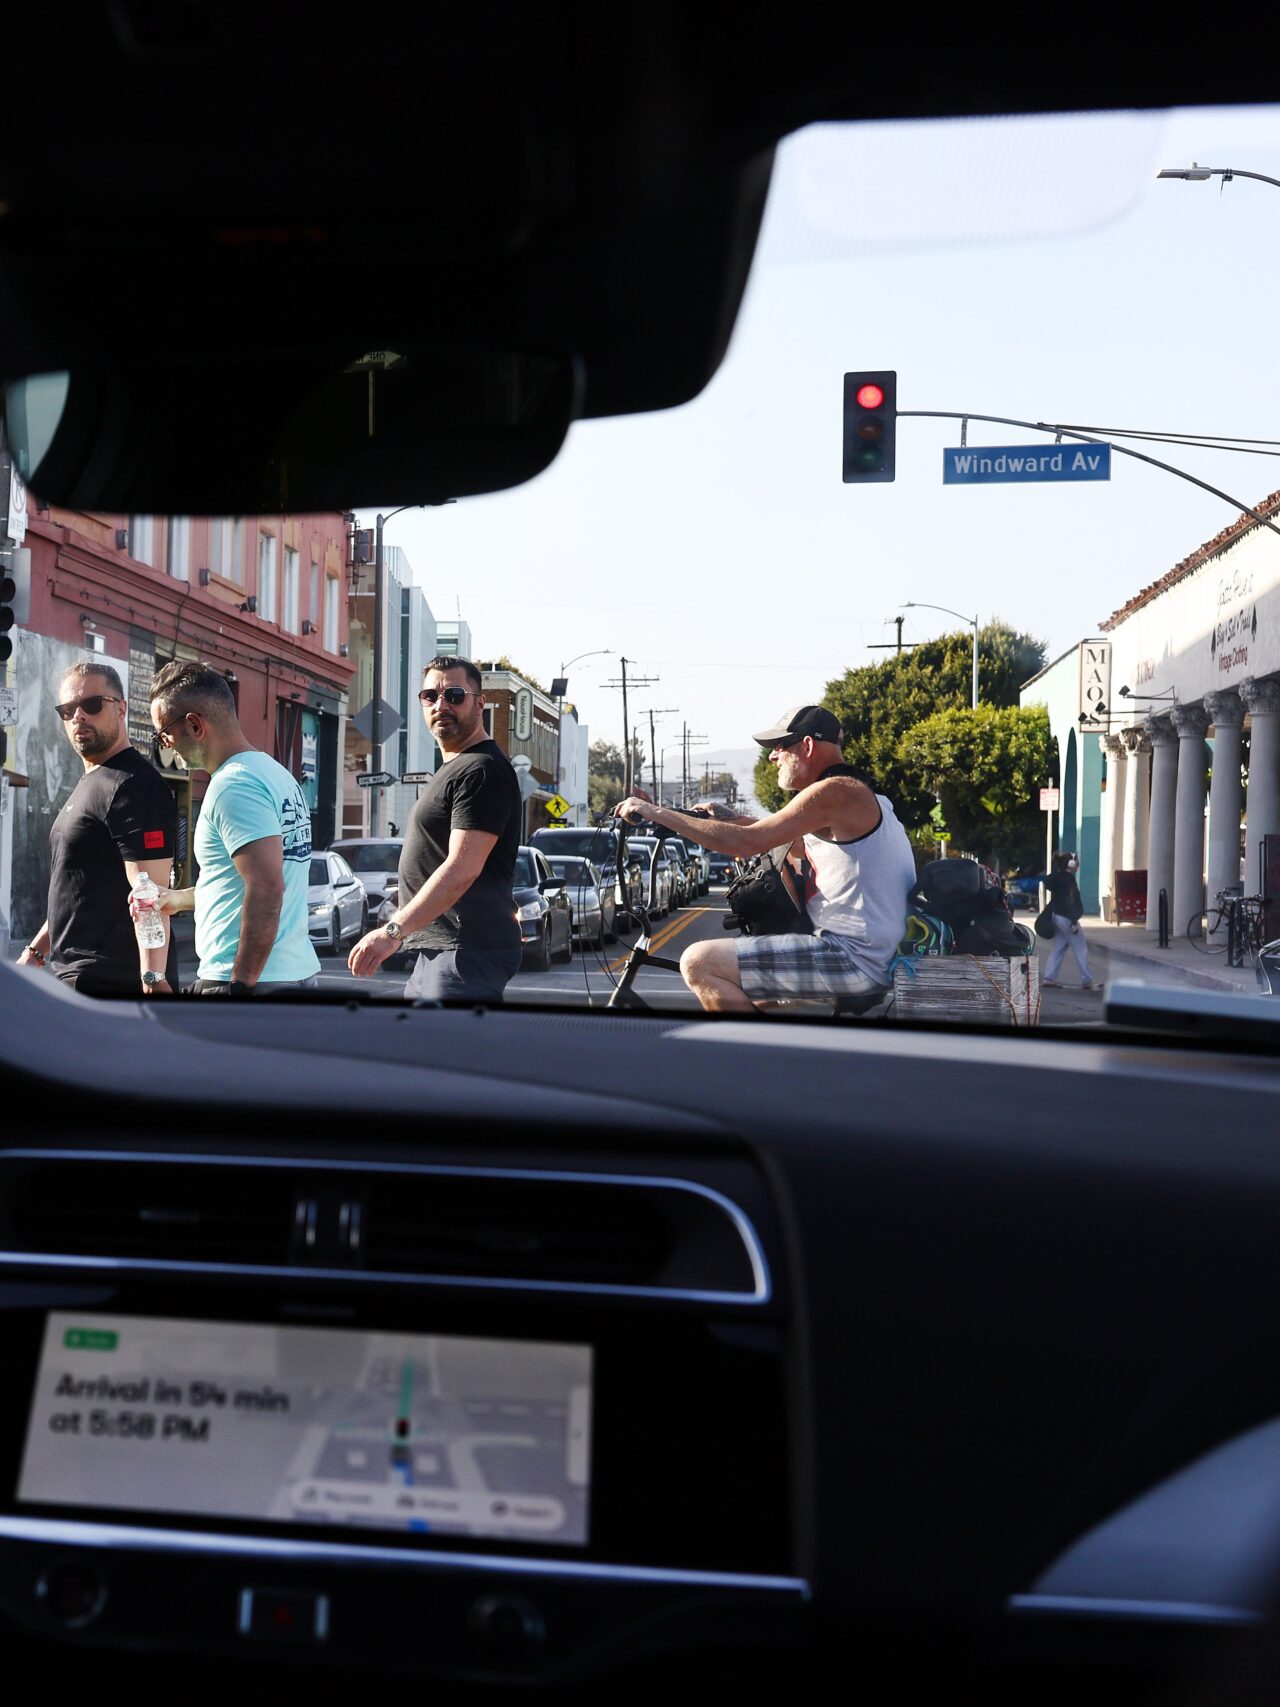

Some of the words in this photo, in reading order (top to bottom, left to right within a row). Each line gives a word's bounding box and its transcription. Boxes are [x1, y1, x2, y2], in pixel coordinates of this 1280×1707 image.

[953, 452, 1063, 474] Windward
[1071, 451, 1101, 471] Av
[54, 1373, 150, 1403] Arrival
[154, 1377, 182, 1405] in
[232, 1385, 291, 1413] min
[48, 1411, 82, 1434] at
[88, 1409, 157, 1440] 5:58
[161, 1414, 212, 1442] PM
